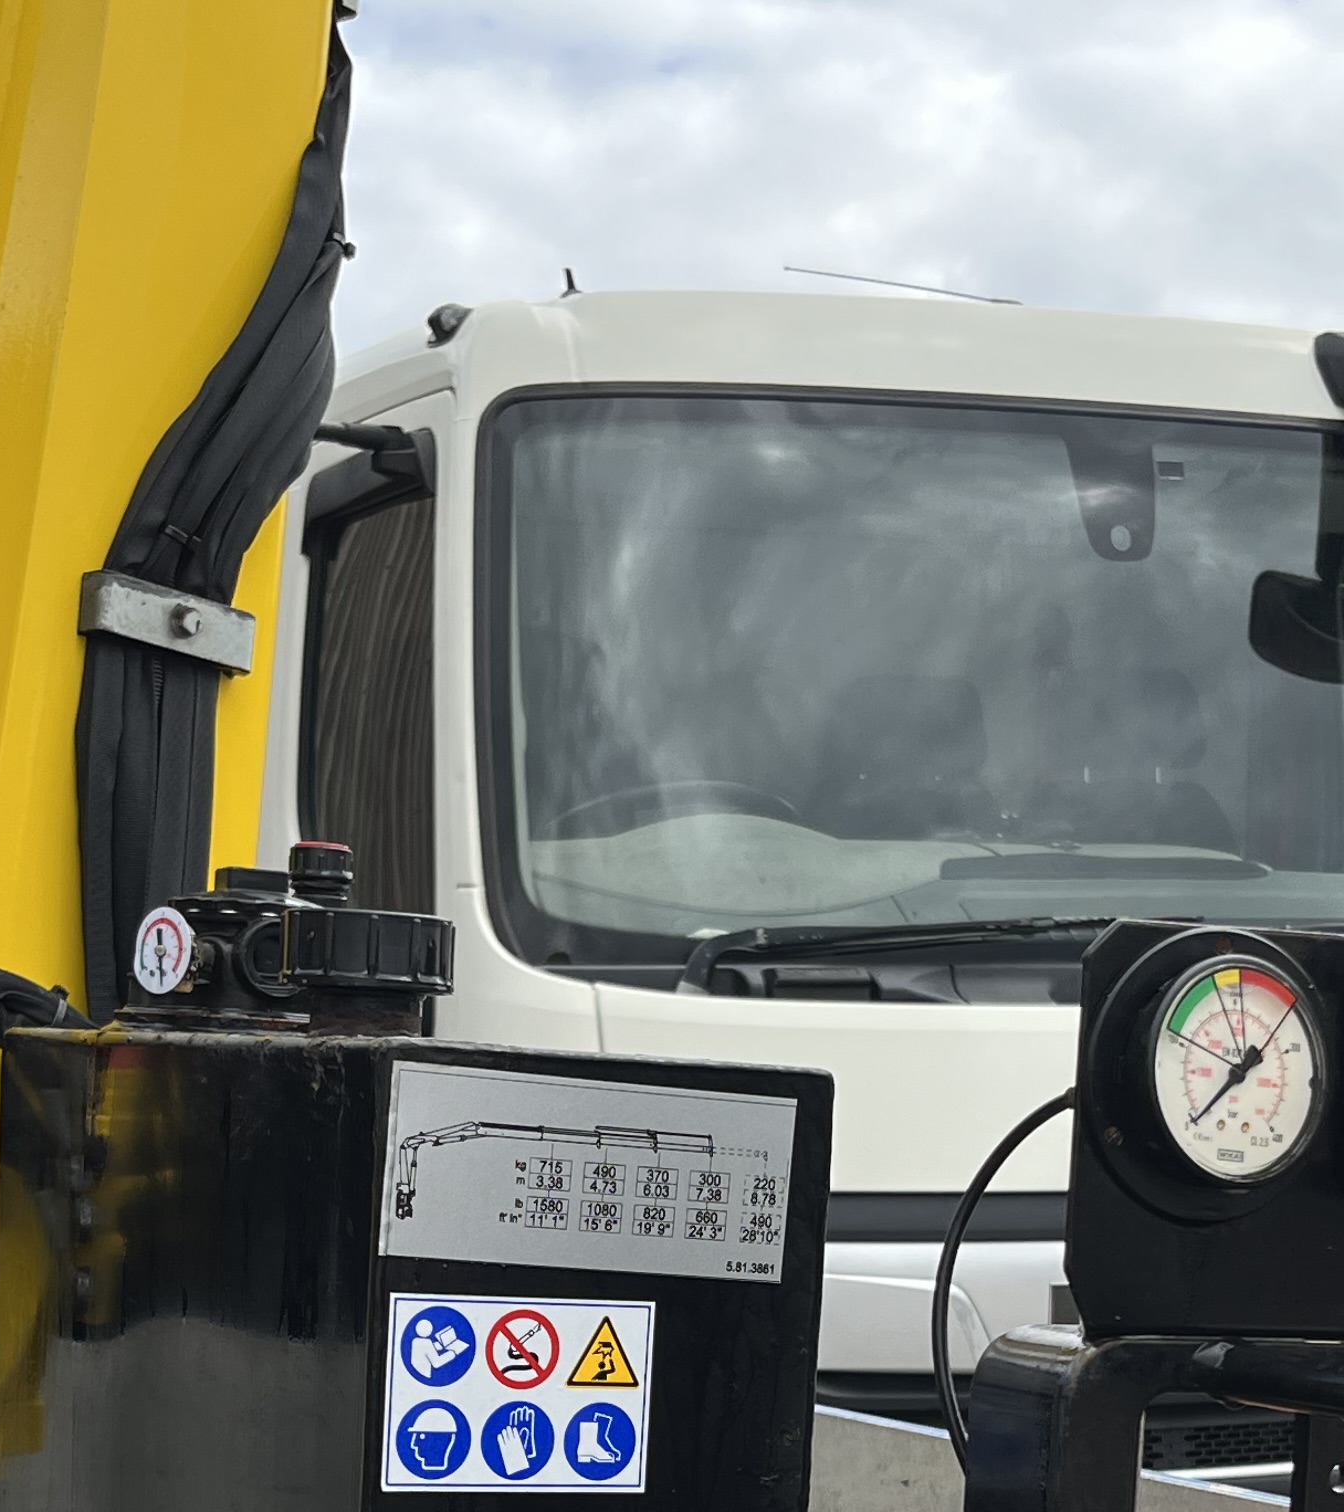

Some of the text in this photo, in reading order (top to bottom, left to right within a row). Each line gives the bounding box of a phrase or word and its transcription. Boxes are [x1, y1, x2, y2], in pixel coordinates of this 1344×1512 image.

[516, 1175, 776, 1206] m 3.38 4.73 6.03 7.38 8.78
[540, 1161, 563, 1174] 715
[593, 1165, 616, 1178] 490
[647, 1169, 669, 1183] 370
[699, 1174, 721, 1187] 300
[754, 1178, 775, 1191] 220
[533, 1199, 563, 1213] 1580
[587, 1204, 617, 1217] 1080
[643, 1208, 665, 1221] 820
[696, 1212, 718, 1224] 660
[750, 1216, 772, 1229] 490
